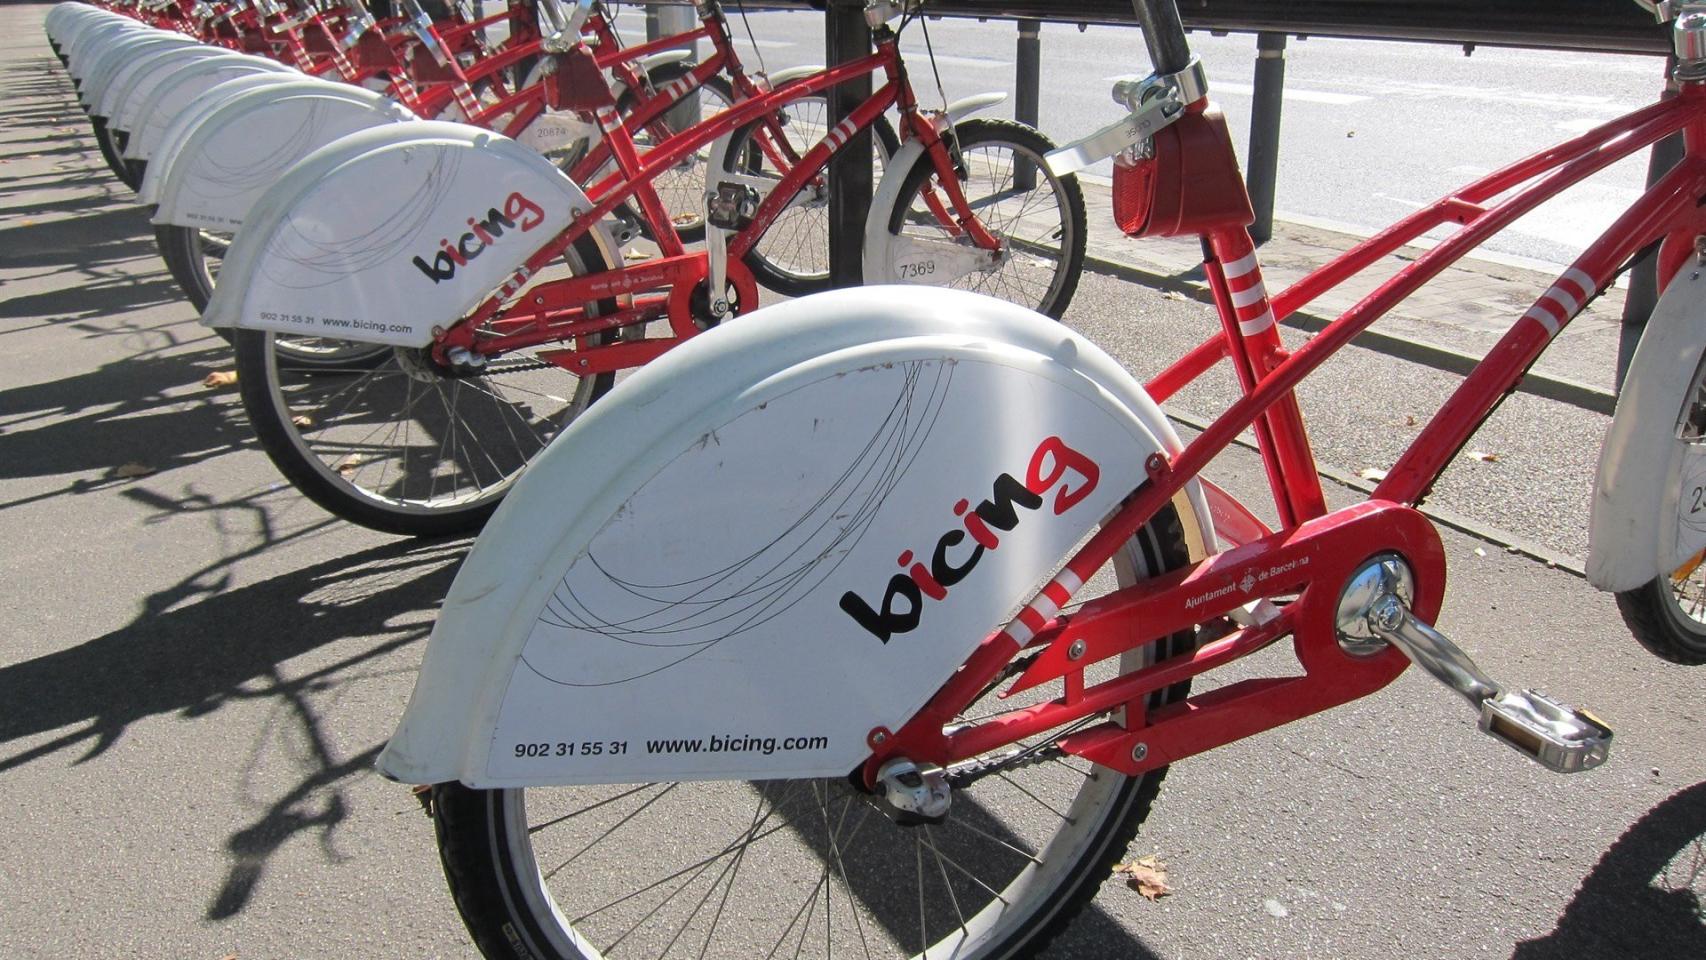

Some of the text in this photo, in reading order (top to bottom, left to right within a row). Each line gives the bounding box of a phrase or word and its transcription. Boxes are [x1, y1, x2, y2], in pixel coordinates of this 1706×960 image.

[412, 191, 544, 284] bicing
[900, 261, 935, 279] 7369
[260, 311, 277, 320] 902
[291, 315, 302, 323] 55
[304, 316, 314, 324] 31
[322, 317, 412, 333] www.bicing.com
[839, 436, 1099, 645] bicing
[1185, 582, 1236, 609] Ajuntament
[1258, 571, 1269, 581] de
[514, 735, 828, 757] 902 31 55 31 www.bicing.com
